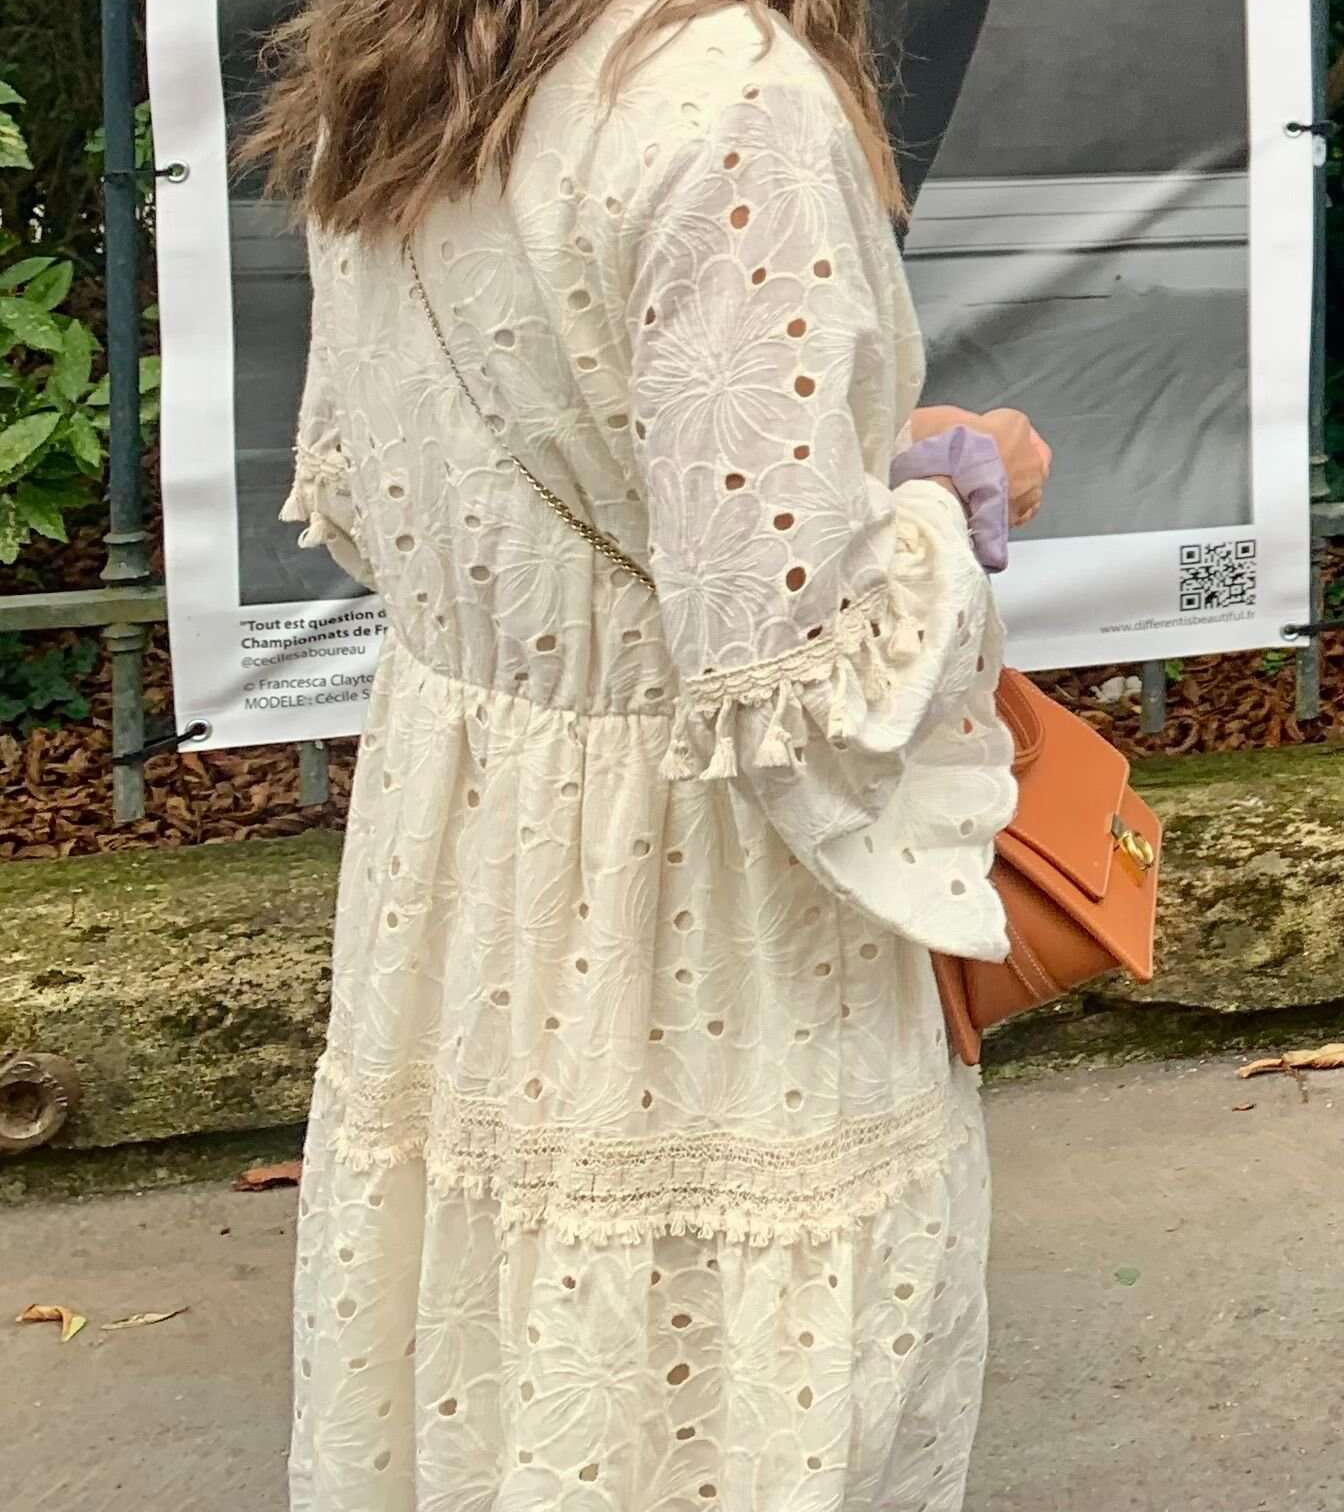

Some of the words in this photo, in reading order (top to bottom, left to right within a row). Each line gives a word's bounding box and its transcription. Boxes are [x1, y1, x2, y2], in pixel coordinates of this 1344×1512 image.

[284, 619, 304, 630] est
[308, 610, 374, 630] question
[377, 608, 387, 619] d
[1100, 610, 1256, 634] www.differentisbeautiful.fr
[241, 627, 349, 650] Championnats
[352, 626, 371, 637] de
[375, 624, 389, 636] Fr
[258, 677, 327, 691] Francesca
[330, 673, 375, 687] Clayto
[315, 690, 358, 705] Cécile
[362, 688, 370, 700] S
